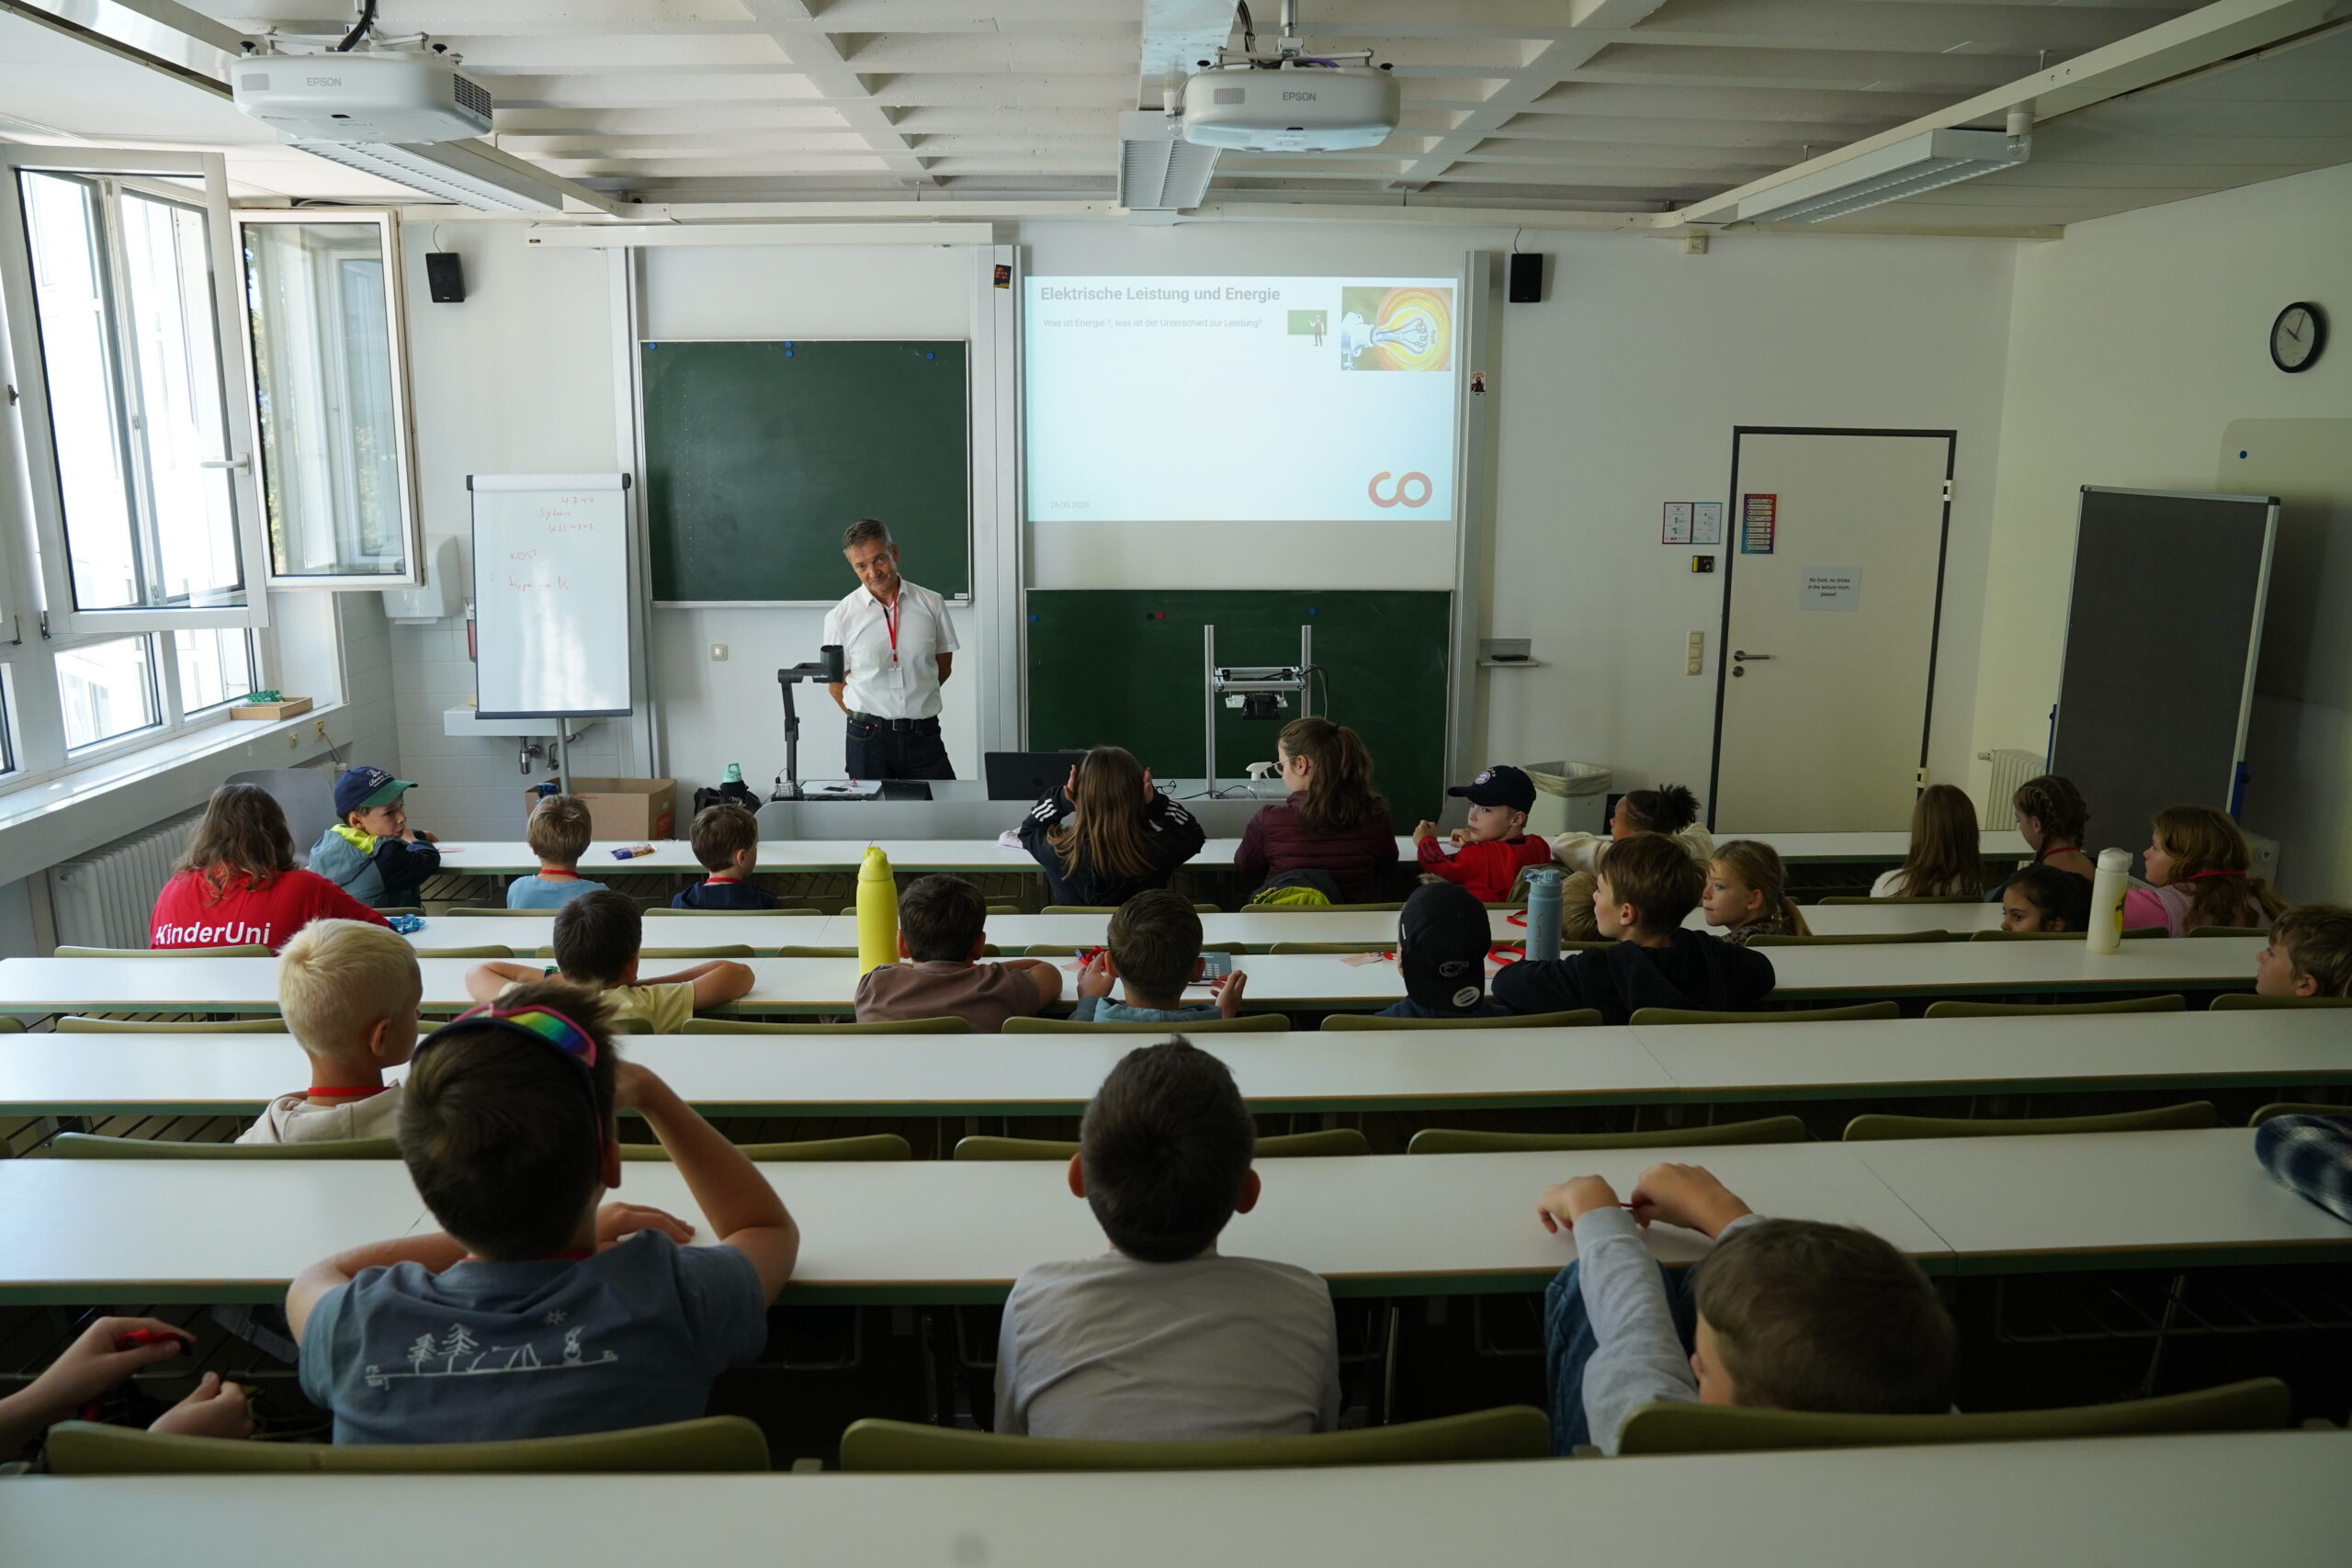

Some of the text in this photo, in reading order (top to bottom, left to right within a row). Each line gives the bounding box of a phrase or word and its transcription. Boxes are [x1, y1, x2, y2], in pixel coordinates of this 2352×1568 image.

[306, 76, 342, 87] EPSON
[1282, 91, 1317, 102] EPSON
[1040, 286, 1281, 303] Elektrische Leistung und Energie
[1043, 319, 1061, 327] Was
[1063, 319, 1073, 327] ist
[1133, 319, 1144, 327] ist
[1145, 319, 1159, 327] der
[1160, 319, 1207, 327] Unterschied
[1224, 319, 1263, 329] Leistung?
[155, 921, 271, 945] KinderUni
